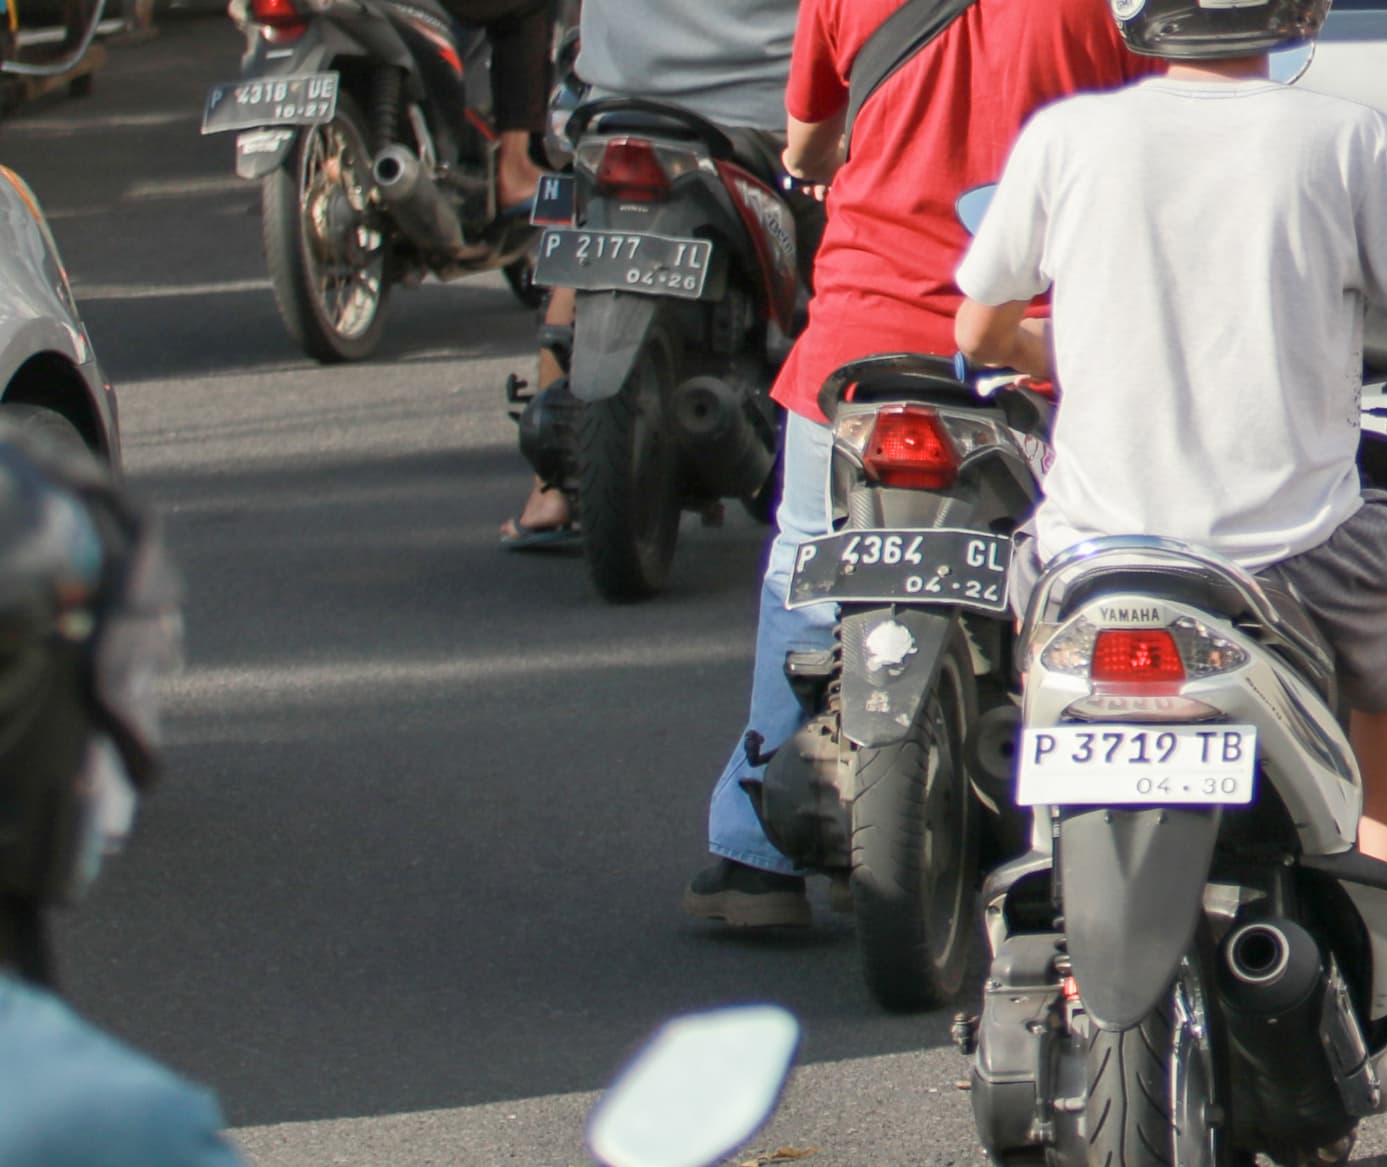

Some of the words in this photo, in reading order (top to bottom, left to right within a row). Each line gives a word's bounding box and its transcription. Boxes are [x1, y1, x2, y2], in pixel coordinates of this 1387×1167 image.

[210, 86, 223, 109] P
[543, 179, 560, 201] N
[546, 234, 561, 258] P
[576, 235, 641, 260] 2177
[674, 243, 701, 268] IL
[797, 544, 817, 573] P
[841, 535, 924, 565] 4364
[966, 540, 1004, 572] GL
[1100, 607, 1160, 623] YAMAHA
[1034, 734, 1055, 765] P
[1071, 732, 1178, 764] 3719
[1196, 731, 1243, 763] TB
